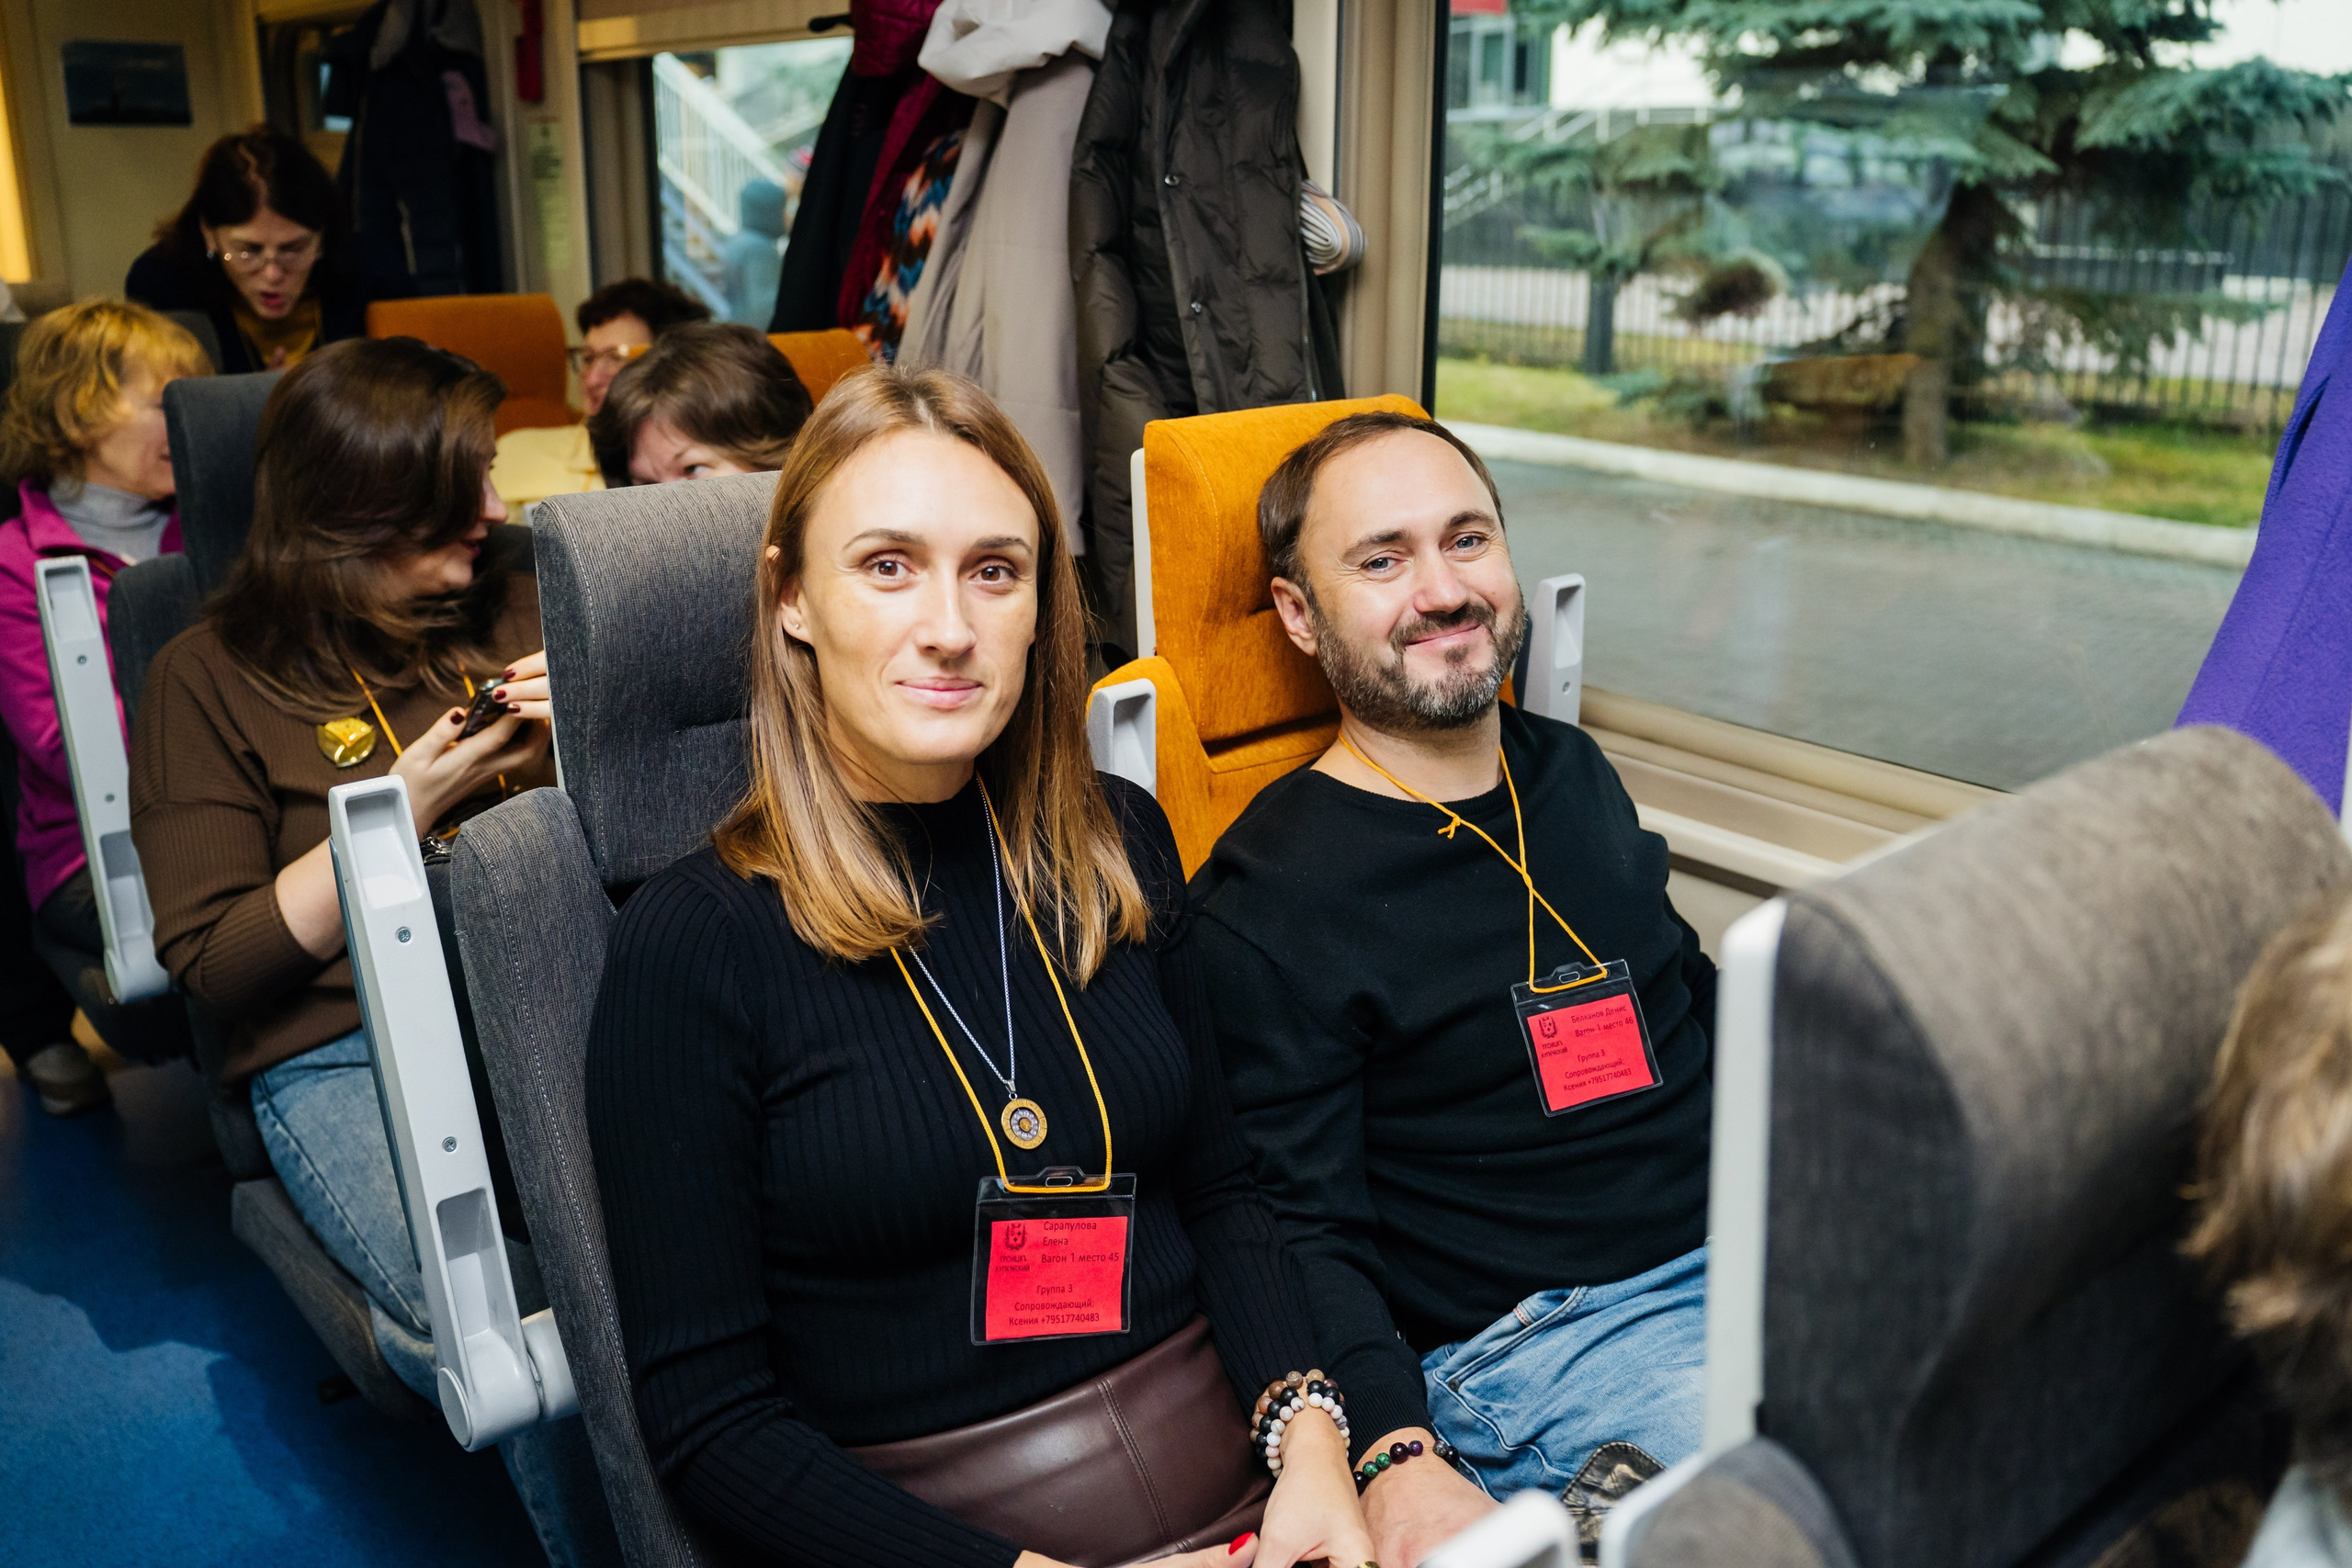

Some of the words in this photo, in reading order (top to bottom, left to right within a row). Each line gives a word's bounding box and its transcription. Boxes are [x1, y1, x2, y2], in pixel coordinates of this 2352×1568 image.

[1575, 1027, 1595, 1037] Вагон
[1603, 1021, 1623, 1031] место
[1577, 1053, 1600, 1064] Группа
[1565, 1058, 1624, 1078] Сопровождающий:
[1564, 1080, 1587, 1091] Ксения
[1588, 1068, 1632, 1085] +79517740483
[1043, 1221, 1097, 1232] Сарапулова
[1043, 1236, 1069, 1247] Елена
[1041, 1254, 1067, 1264] Вагон
[1070, 1252, 1075, 1262] 1
[1079, 1254, 1105, 1262] место
[1108, 1252, 1119, 1261] 45
[1036, 1285, 1065, 1295] Группа
[1068, 1284, 1073, 1293] 3
[1014, 1299, 1094, 1311] Сопровождающий:
[1009, 1316, 1038, 1326] Ксения
[1040, 1314, 1100, 1325] +79517740483
